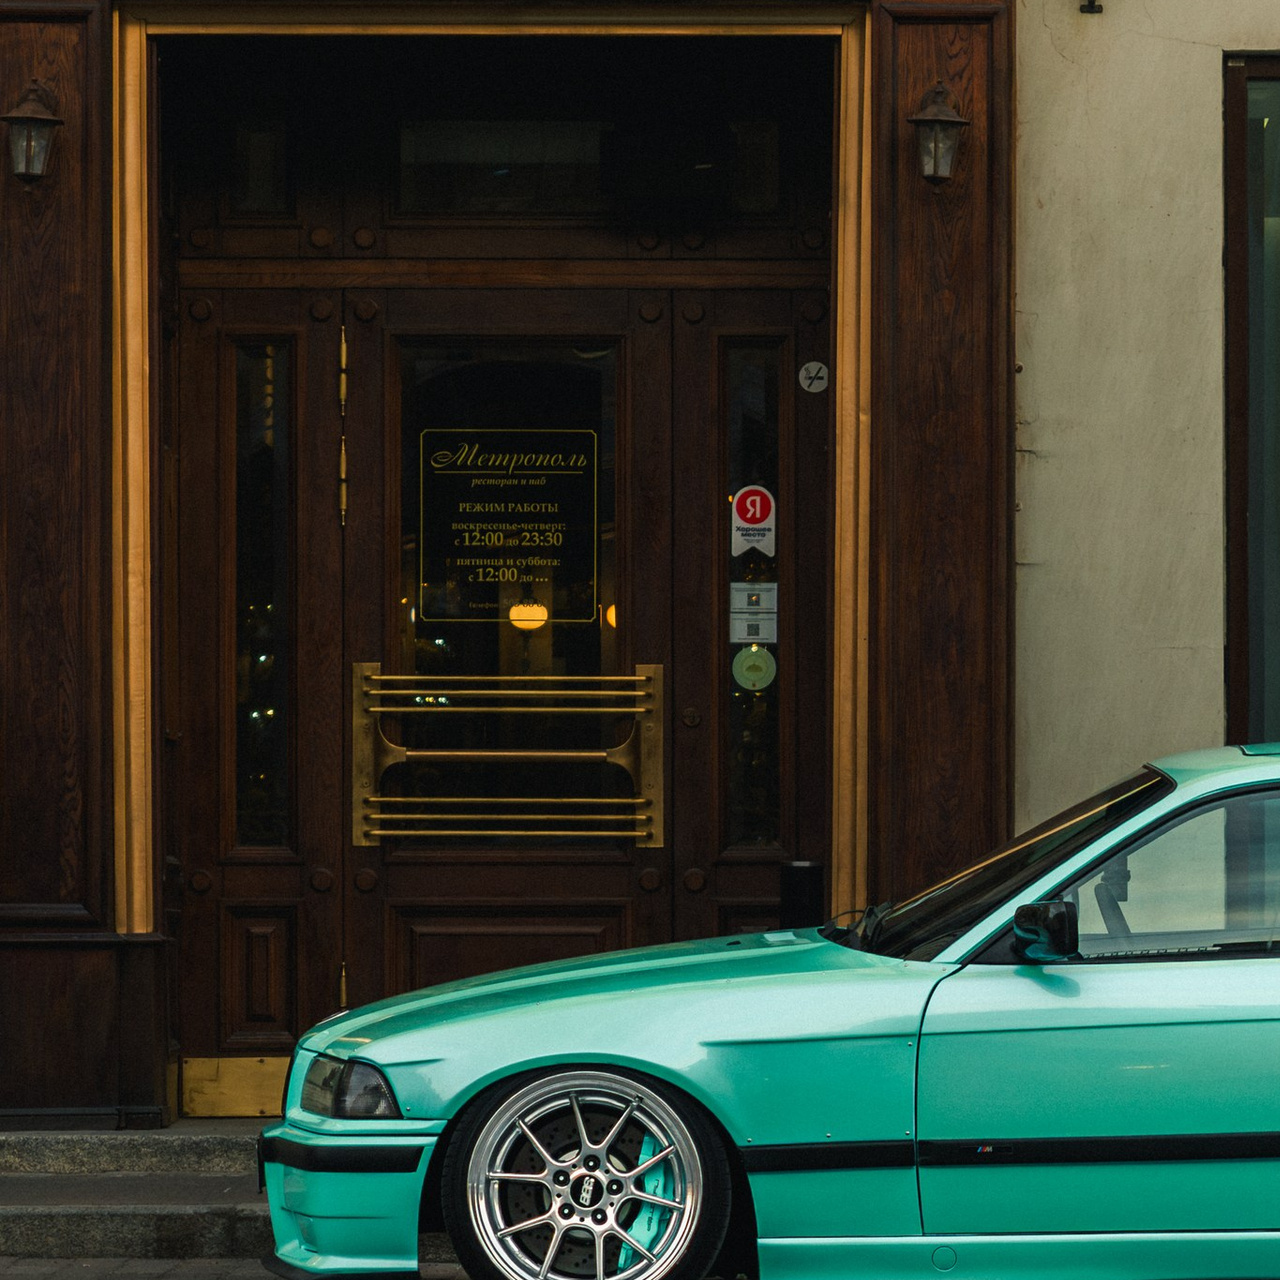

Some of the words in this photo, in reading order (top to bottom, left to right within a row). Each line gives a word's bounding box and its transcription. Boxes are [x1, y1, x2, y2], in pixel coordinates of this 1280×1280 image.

[430, 443, 587, 475] Метрополь
[471, 477, 518, 487] ресторан
[520, 478, 527, 486] и
[529, 476, 546, 486] паб
[459, 503, 505, 512] РЕЖИМ
[508, 503, 559, 512] РАБОТЫ
[745, 495, 761, 519] Я
[451, 523, 566, 533] воскресенье-четверг:
[735, 525, 772, 533] Хорошее
[462, 531, 504, 546] 12:00
[505, 538, 519, 547] до
[521, 531, 563, 546] 23:30
[457, 558, 504, 567] пятница
[506, 558, 514, 566] и
[516, 556, 561, 569] суббота:
[476, 567, 518, 582] 12:00
[519, 574, 533, 583] до
[579, 1176, 595, 1206] BBS
